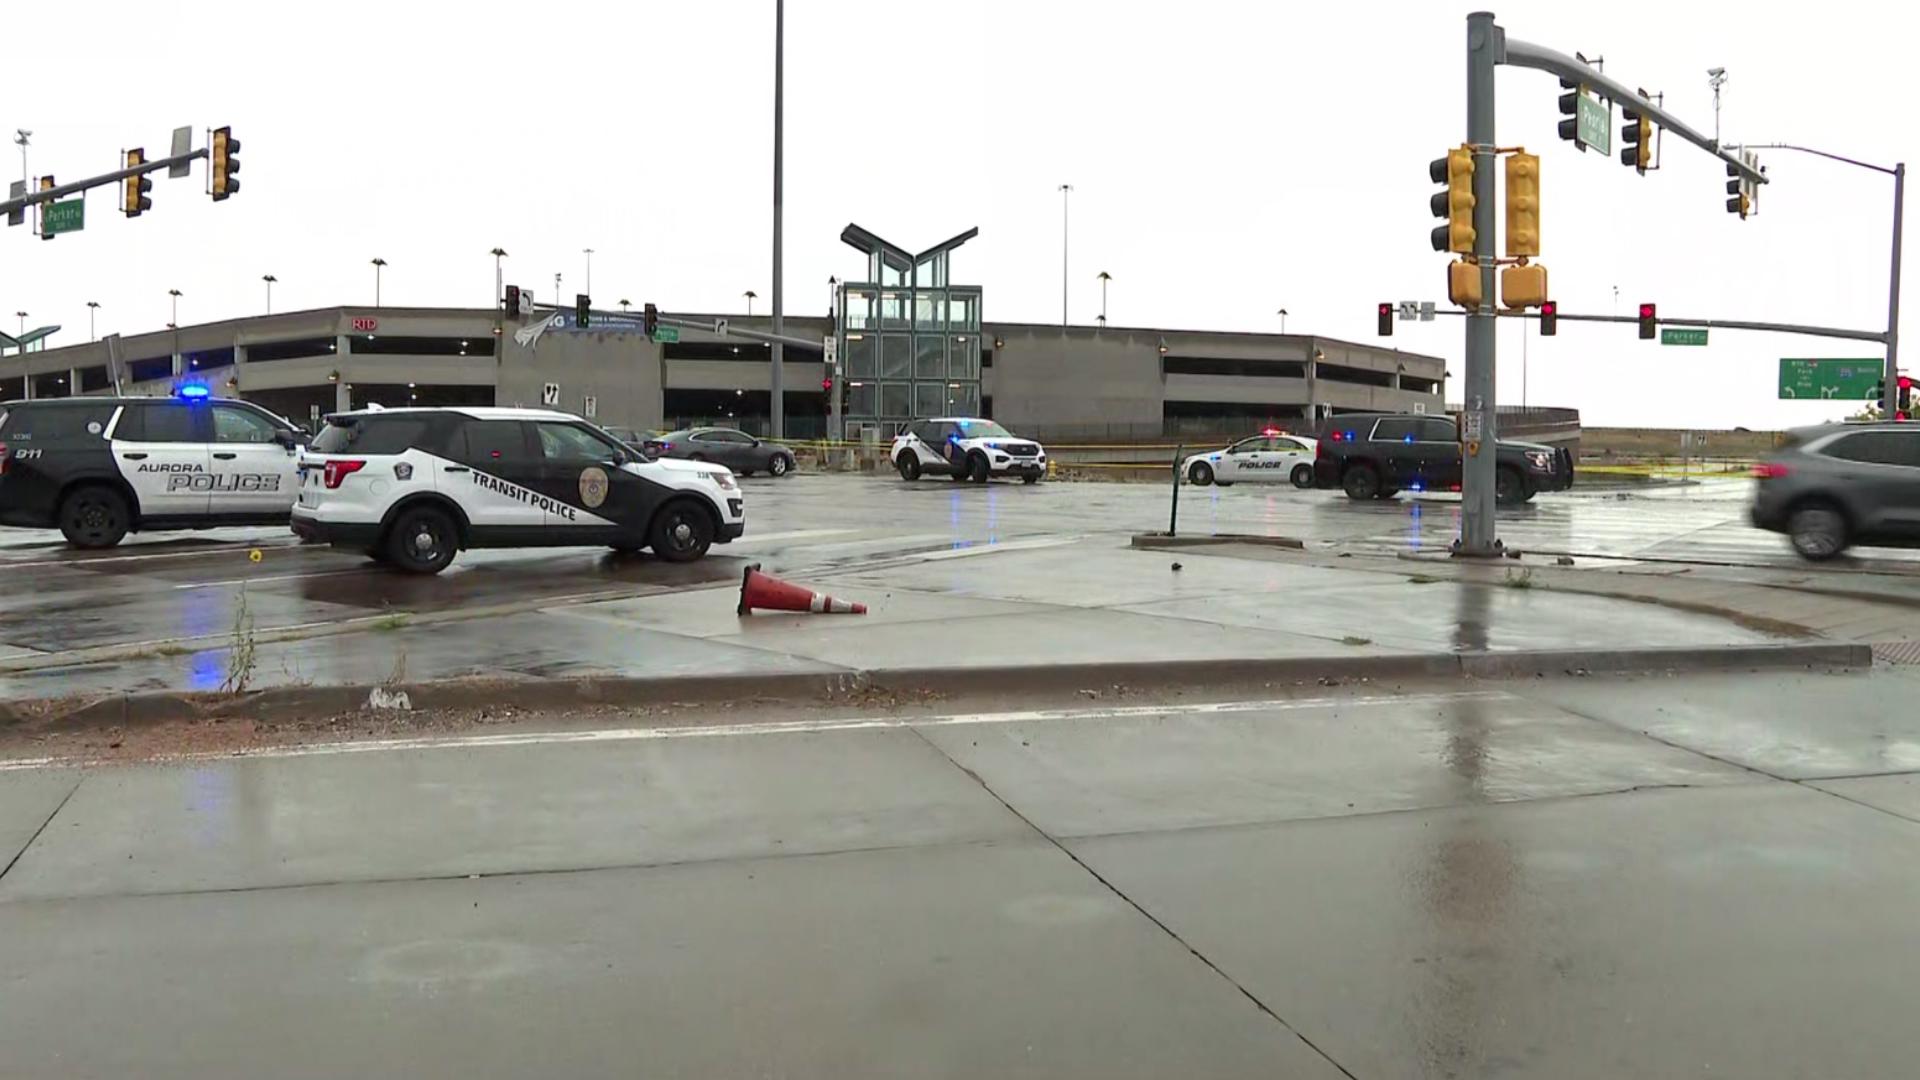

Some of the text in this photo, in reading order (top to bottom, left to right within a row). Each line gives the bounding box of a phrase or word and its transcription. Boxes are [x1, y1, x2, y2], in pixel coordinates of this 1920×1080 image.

[48, 208, 74, 222] Parker
[352, 318, 377, 330] RTD
[1668, 331, 1698, 341] Parker
[15, 448, 43, 460] 911
[137, 463, 204, 473] AURORA
[1237, 460, 1282, 470] POLICE
[166, 473, 282, 492] POLICE
[472, 471, 577, 521] TRANSIT POLICE
